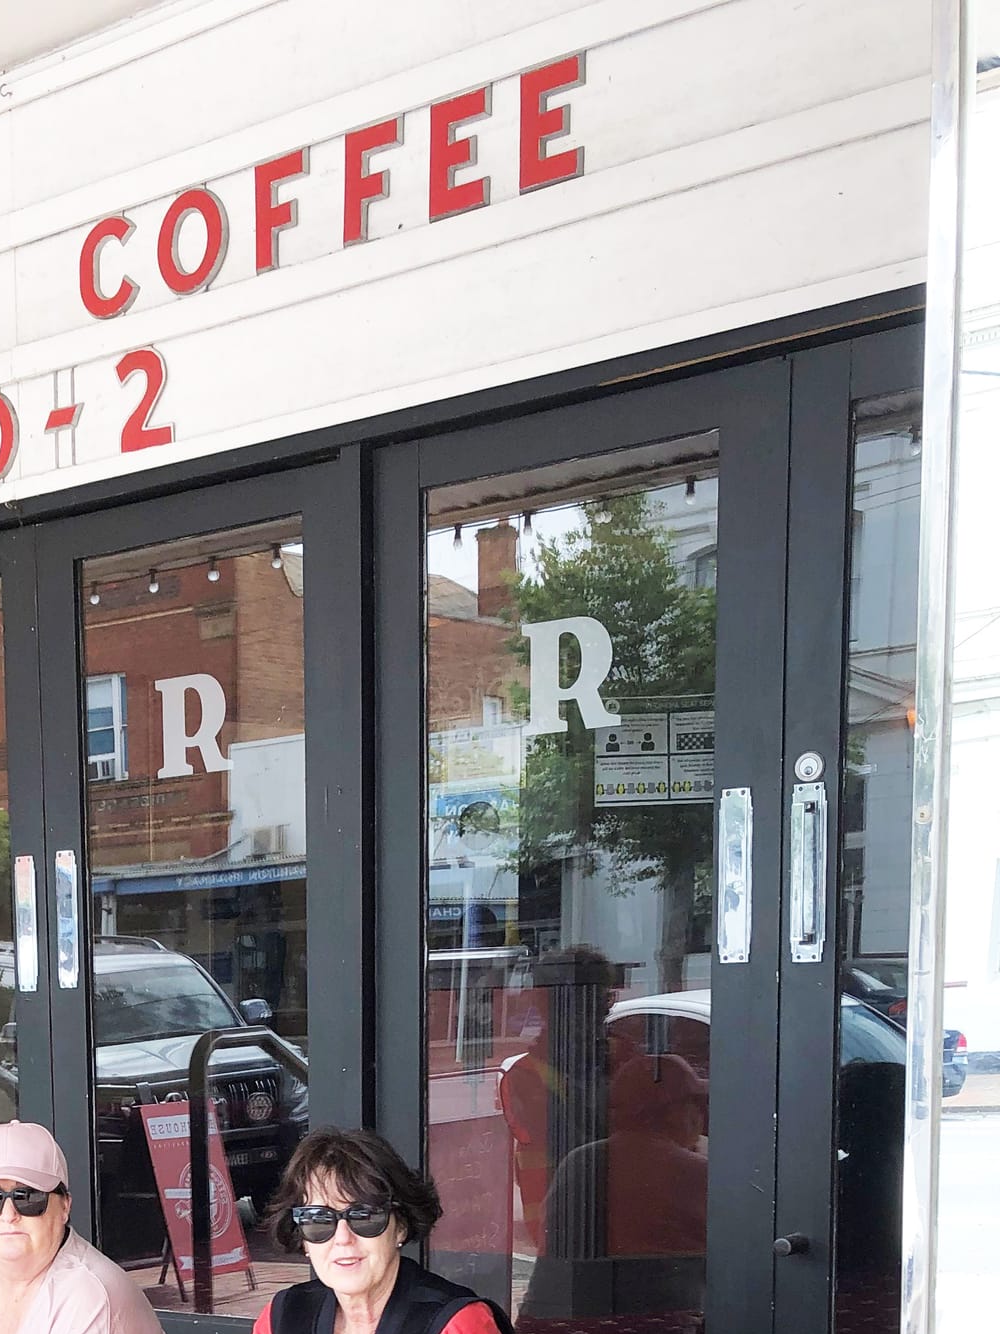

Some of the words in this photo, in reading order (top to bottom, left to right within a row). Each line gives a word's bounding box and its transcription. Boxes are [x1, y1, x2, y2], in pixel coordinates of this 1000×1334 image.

[79, 50, 587, 320] COFFEE
[154, 673, 234, 779] R
[522, 616, 622, 736] R
